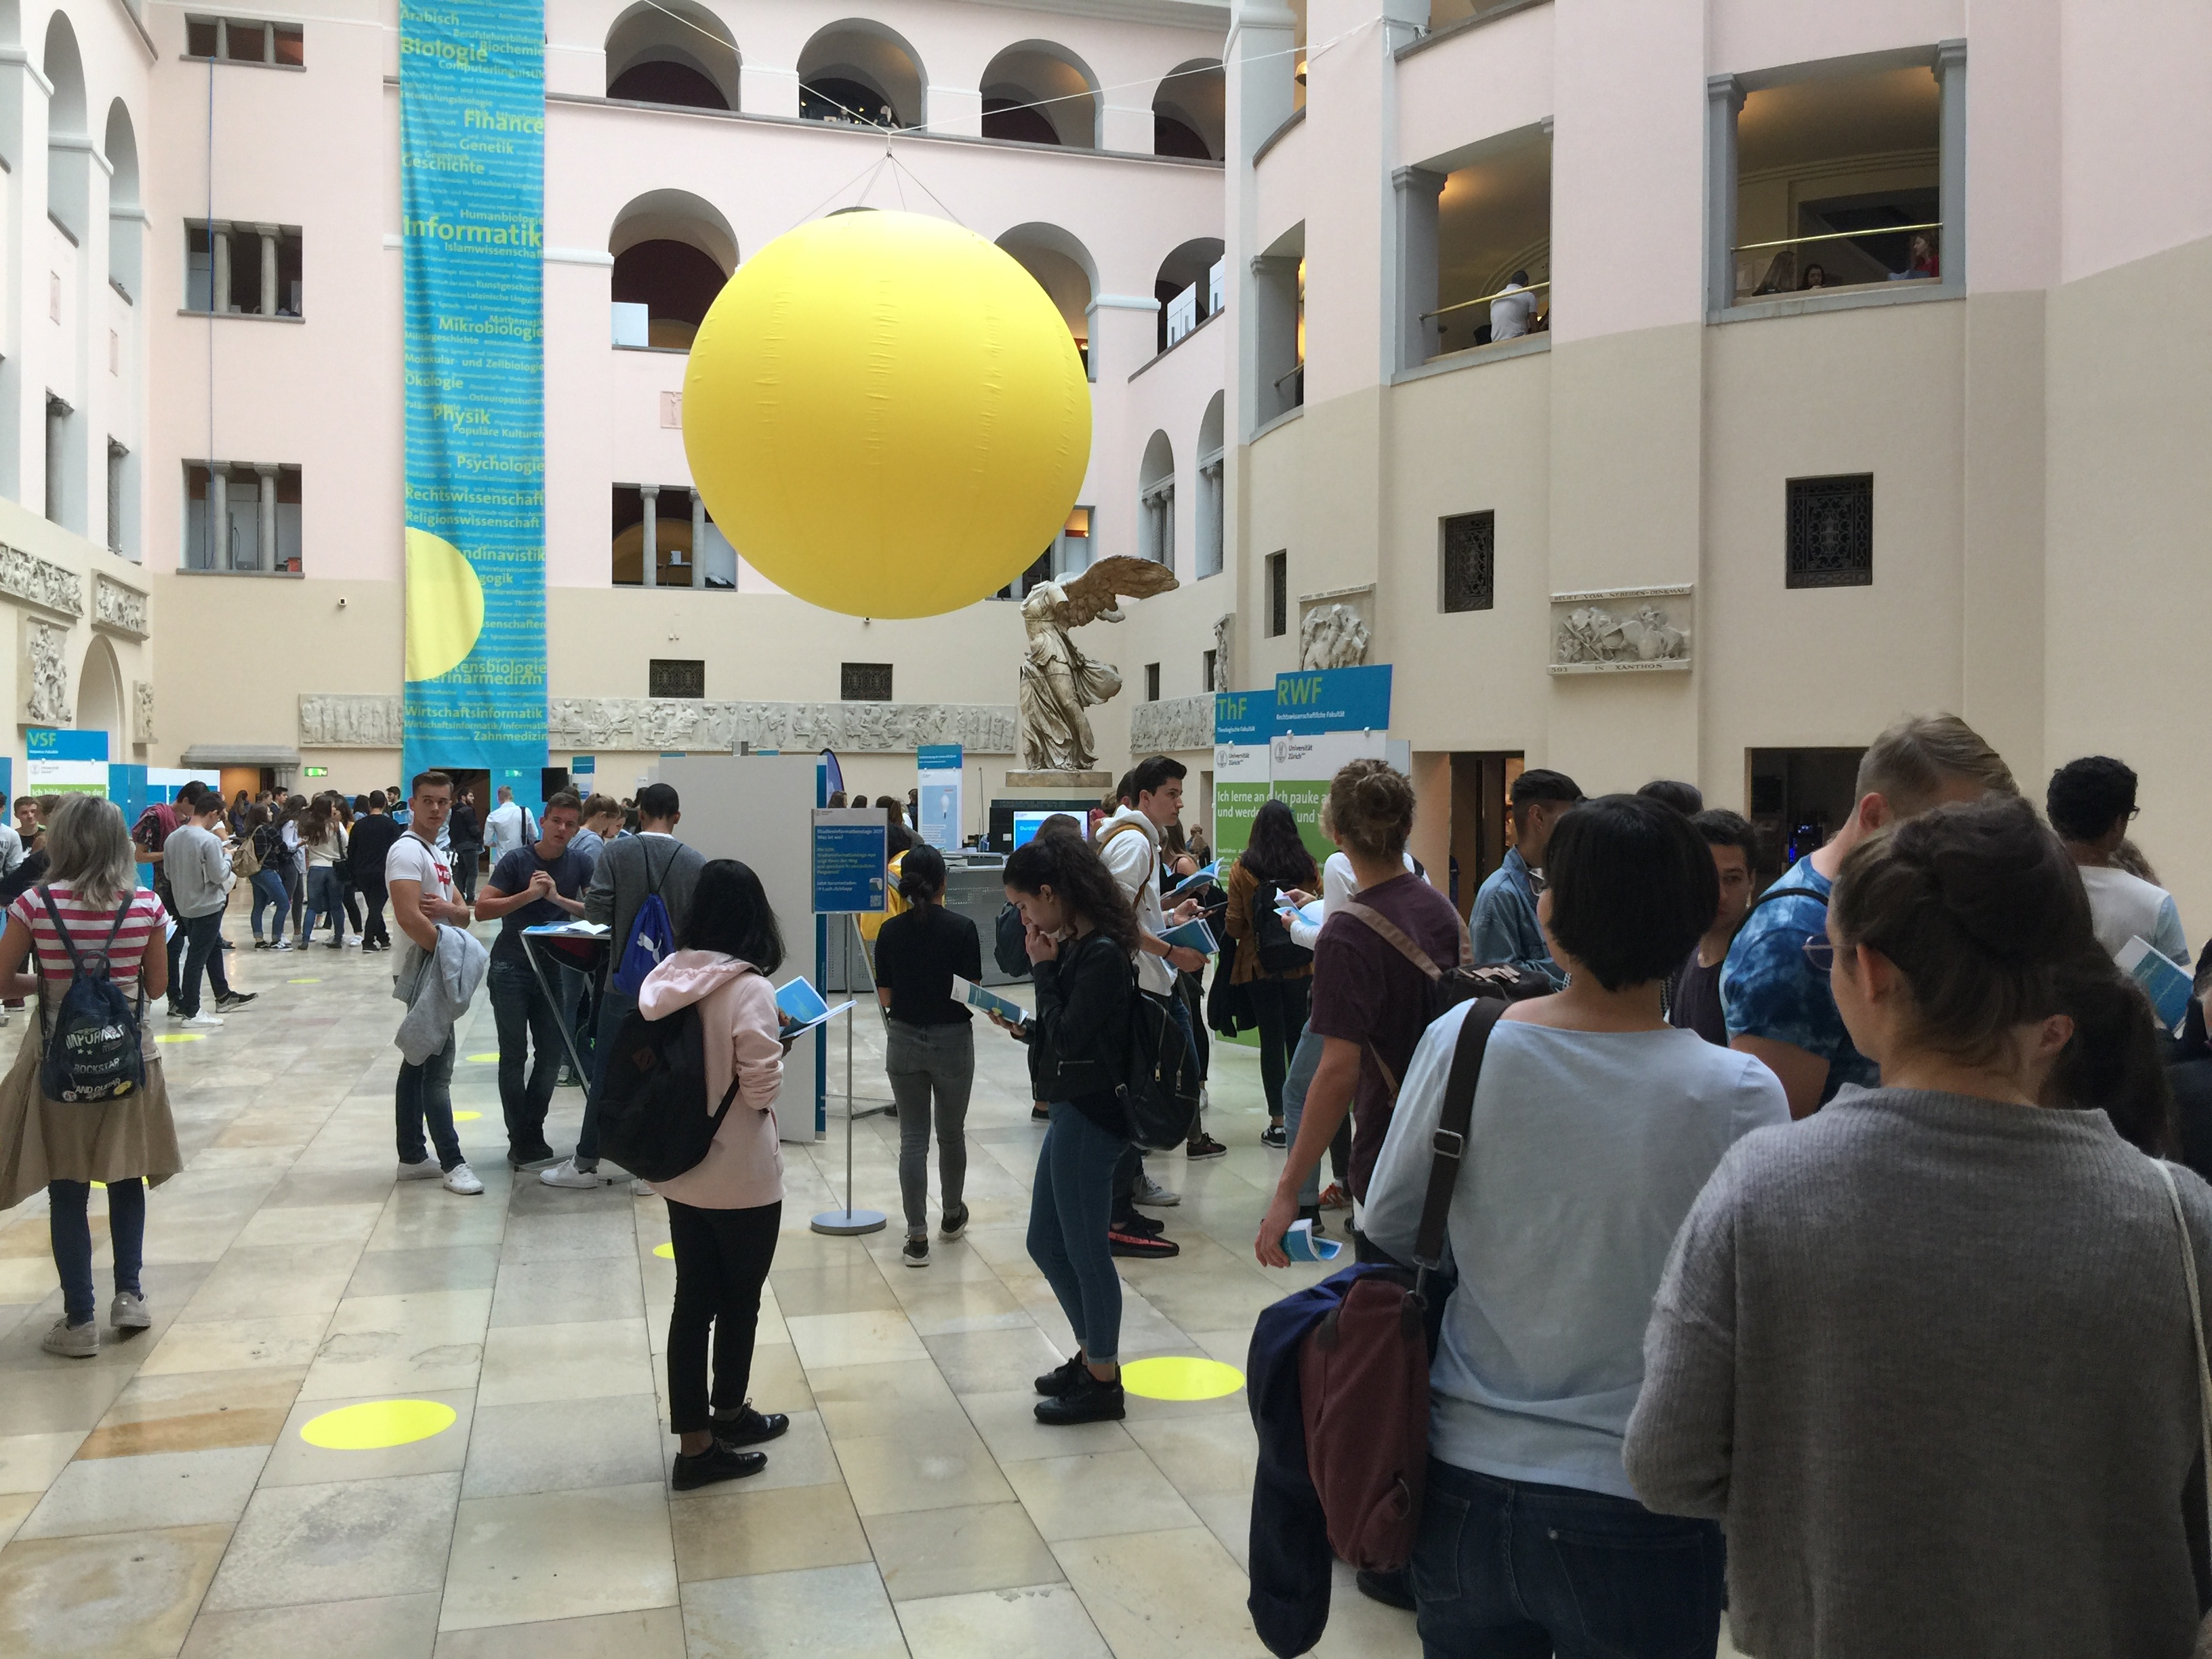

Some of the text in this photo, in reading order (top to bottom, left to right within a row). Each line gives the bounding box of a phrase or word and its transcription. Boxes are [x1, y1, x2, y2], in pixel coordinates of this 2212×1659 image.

[401, 9, 460, 26] Arabisch
[401, 37, 488, 66] Biologie
[464, 108, 545, 135] Finance
[459, 138, 514, 155] Genetik
[401, 156, 485, 175] Geschichte
[403, 213, 543, 248] Informatik
[438, 316, 544, 342] Mikrobiologie
[462, 359, 483, 368] und
[433, 405, 491, 426] Physik
[456, 453, 545, 476] Psychologie
[405, 483, 544, 506] Rechtswissenschaft
[405, 510, 540, 528] Religionswissenschaft
[462, 547, 546, 562] ndinavistik
[481, 619, 546, 630] senschaften
[451, 659, 548, 678] tensbiologie
[1276, 676, 1323, 706] RWF
[405, 705, 543, 719] Wirtschaftsinformatik
[1216, 697, 1247, 720] ThF
[28, 732, 57, 747] VSF
[473, 731, 548, 741] Zahnmedizin
[1217, 790, 1265, 802] Ich lerne an
[1274, 790, 1288, 804] Ich
[1289, 790, 1319, 807] pauke
[1217, 806, 1233, 818] und
[1296, 809, 1315, 823] und
[75, 1085, 94, 1093] AND
